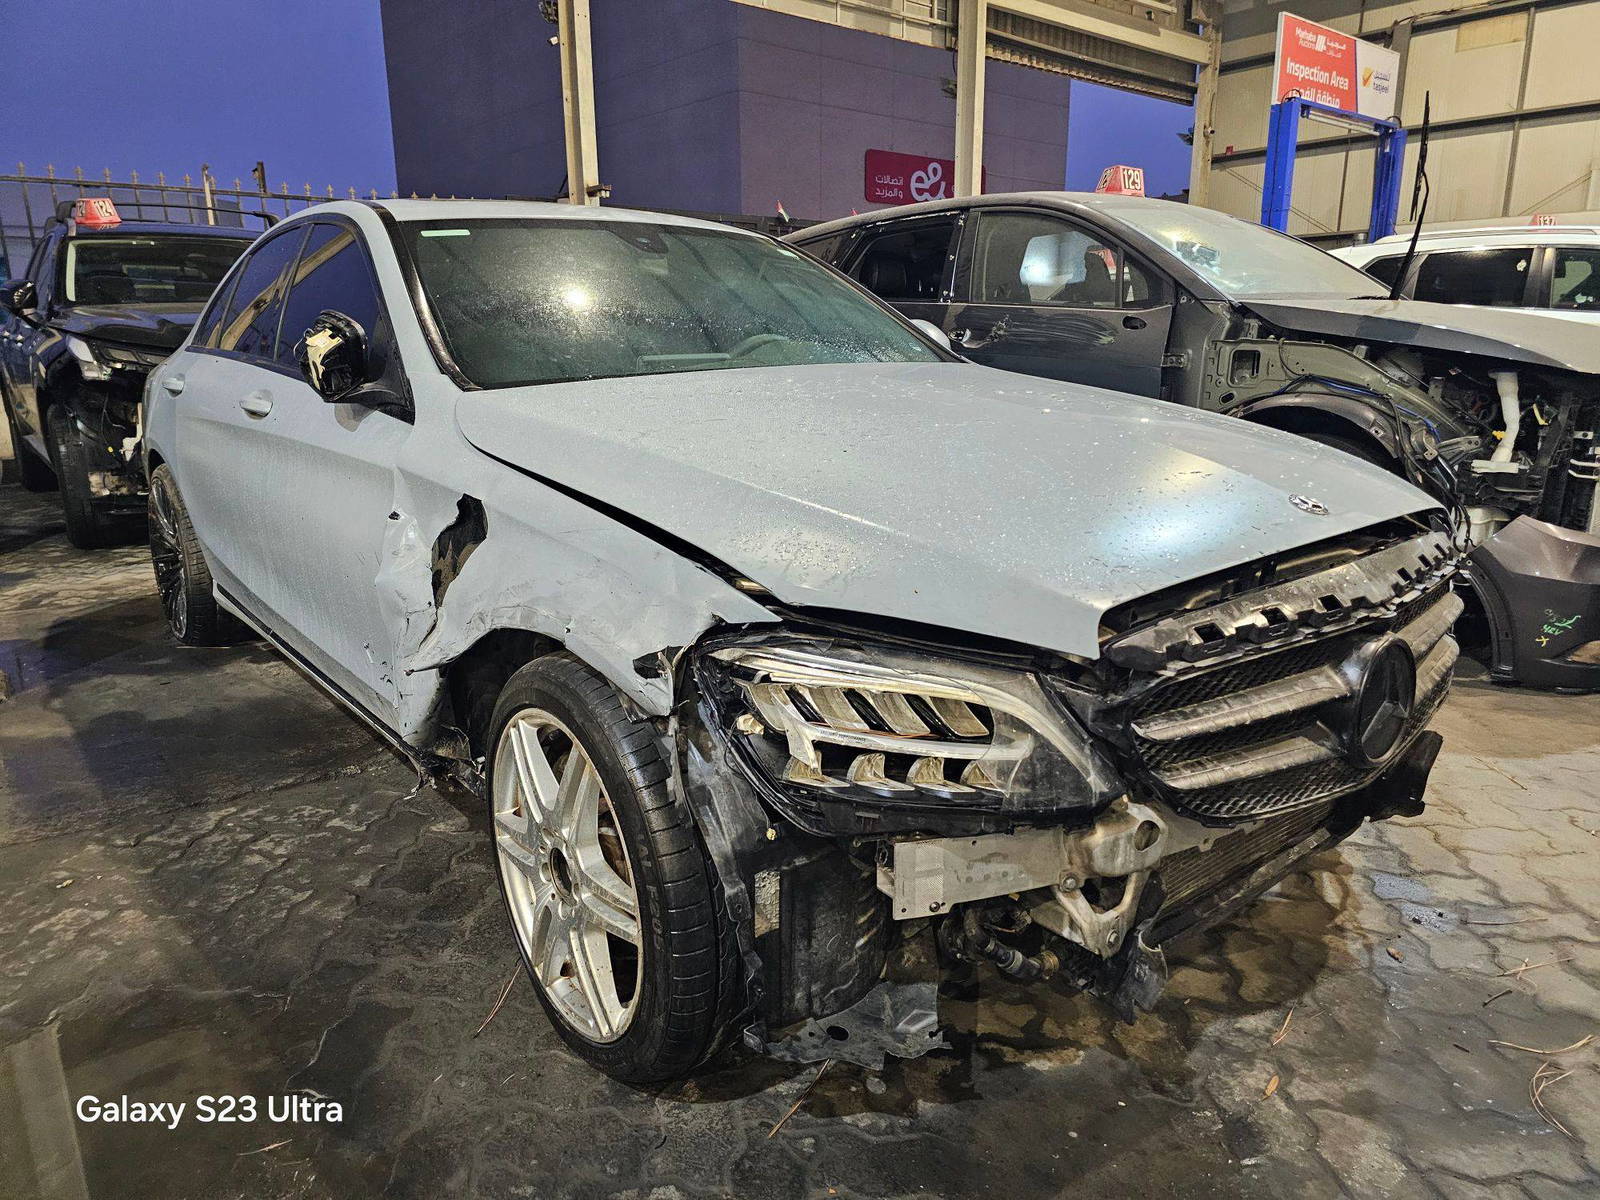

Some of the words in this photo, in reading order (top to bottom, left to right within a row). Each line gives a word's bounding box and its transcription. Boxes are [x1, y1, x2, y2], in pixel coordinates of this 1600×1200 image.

[1287, 58, 1329, 84] Inspection
[1330, 71, 1349, 91] Area
[1123, 169, 1142, 190] 129
